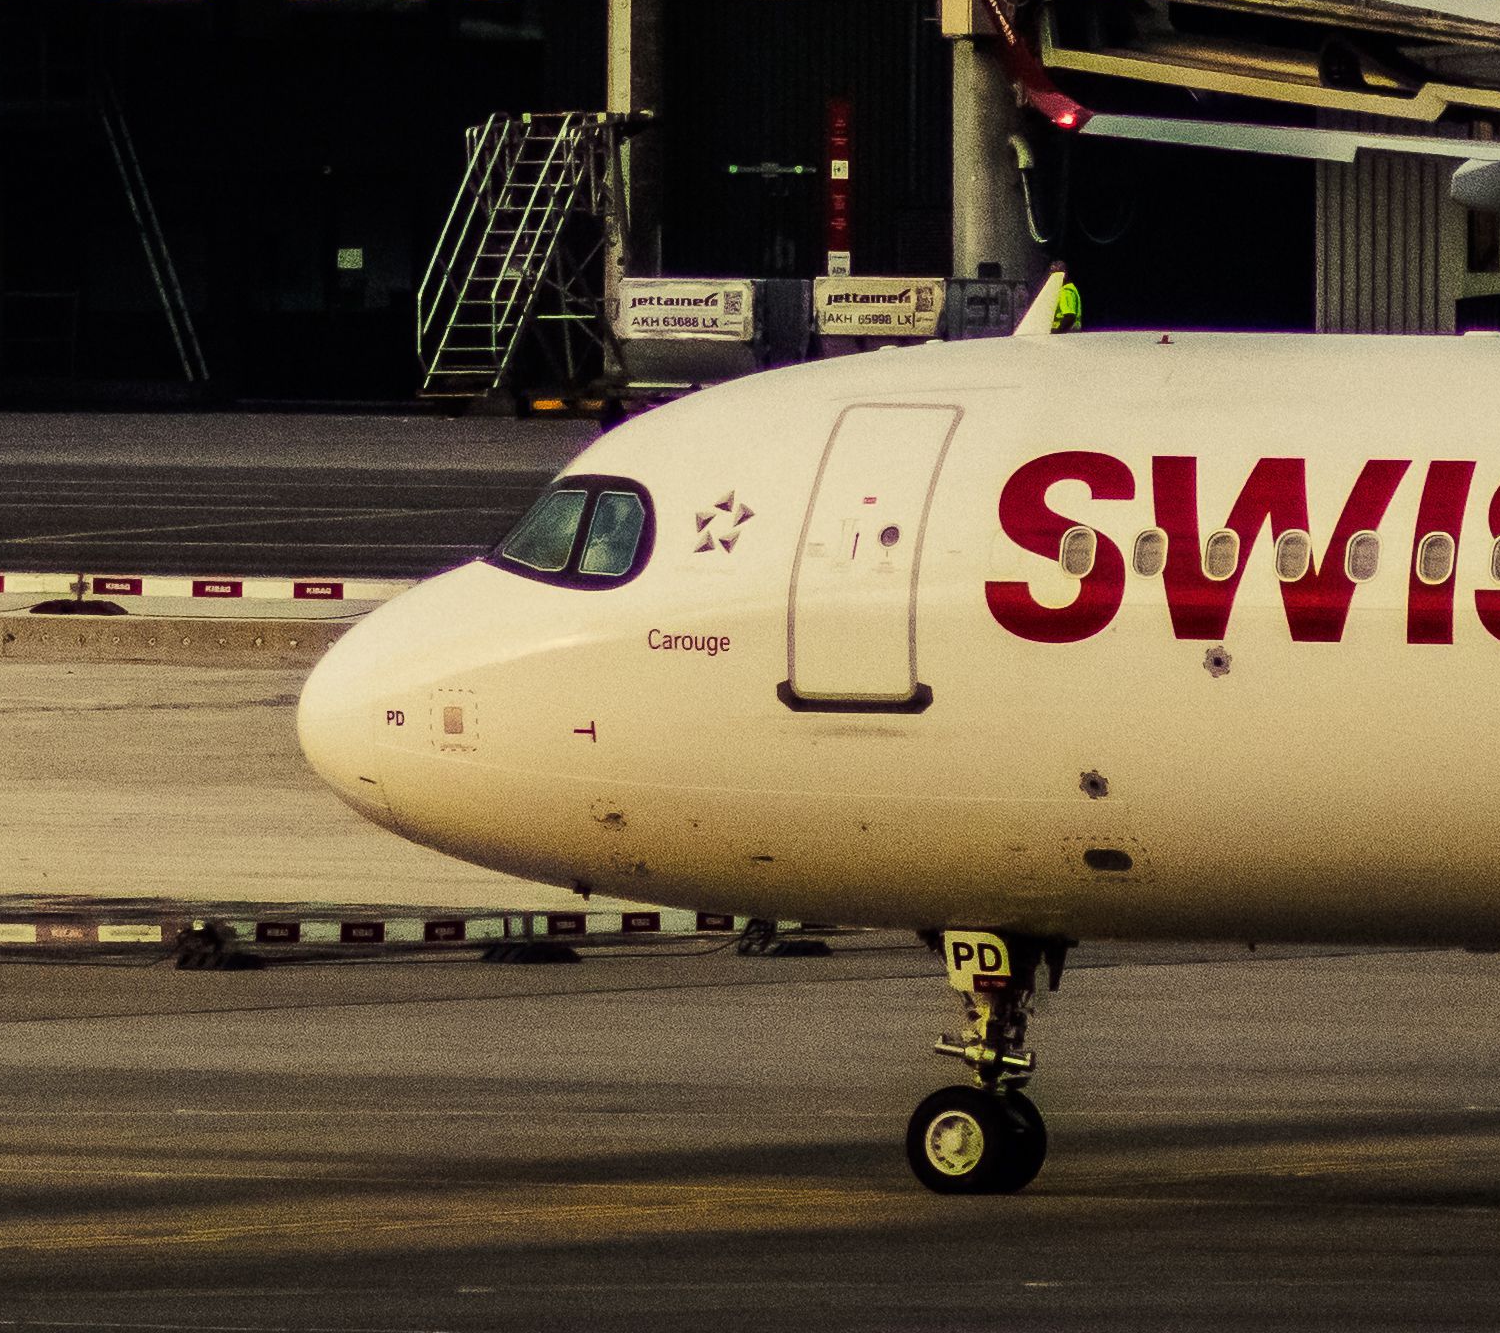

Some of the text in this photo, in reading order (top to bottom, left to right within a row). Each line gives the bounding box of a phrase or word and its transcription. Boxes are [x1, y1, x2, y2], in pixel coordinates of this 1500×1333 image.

[629, 293, 718, 309] jettainer
[826, 288, 911, 306] jettainer
[702, 318, 719, 328] LX
[897, 314, 913, 325] LX
[648, 628, 730, 656] Carouge
[386, 710, 405, 726] PD
[952, 942, 1003, 972] PD
